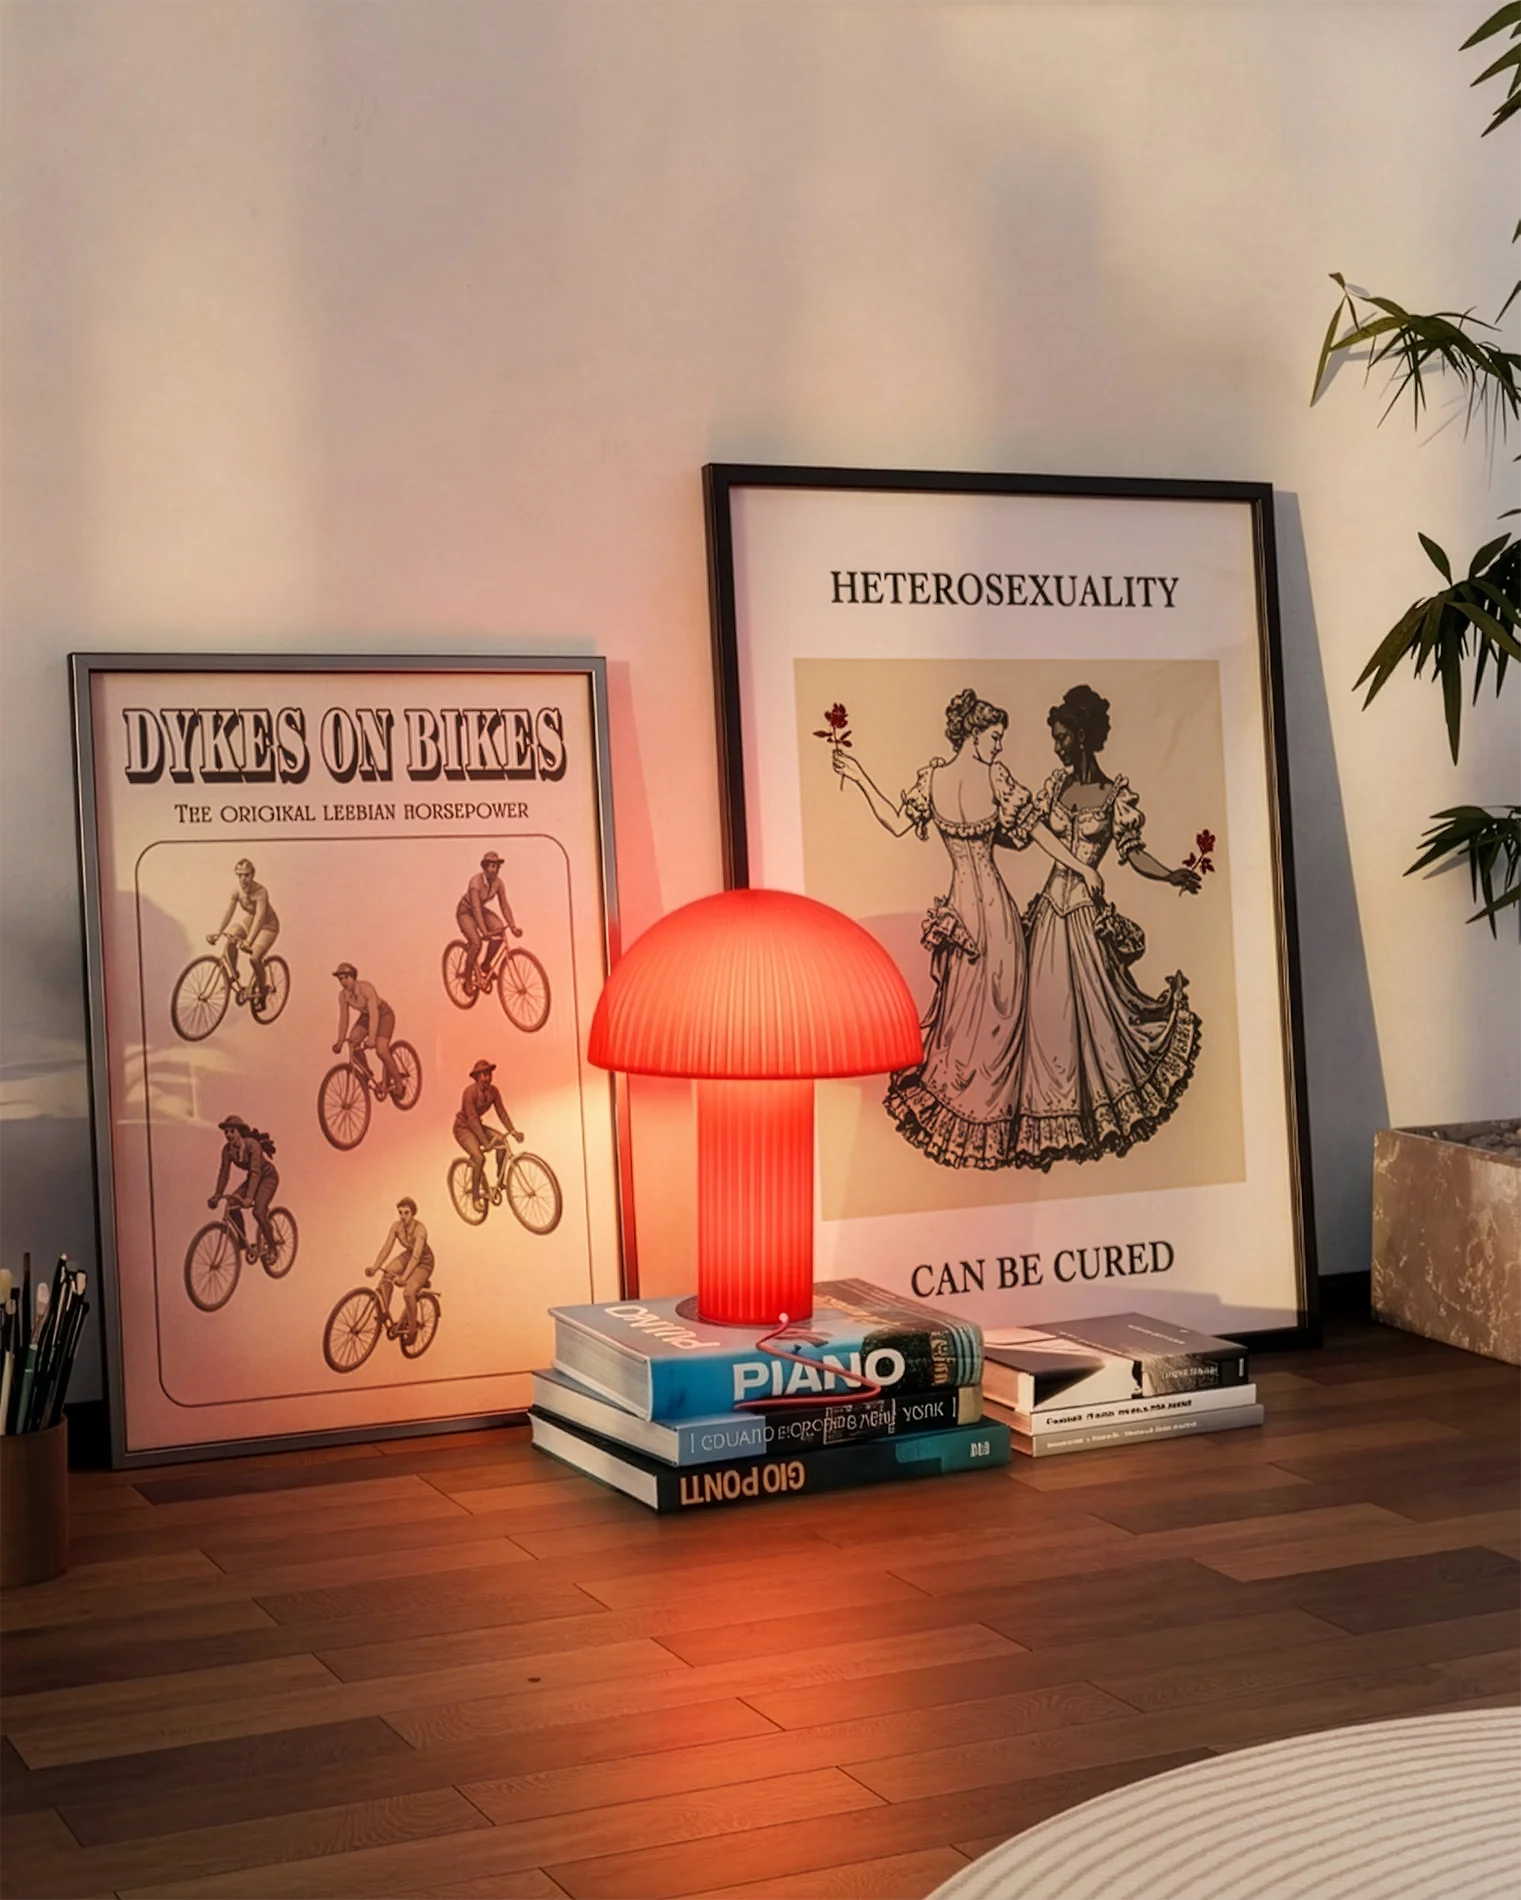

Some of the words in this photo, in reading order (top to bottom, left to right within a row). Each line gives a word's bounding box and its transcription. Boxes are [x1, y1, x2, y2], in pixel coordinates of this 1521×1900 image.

[831, 571, 1180, 607] HETEROSEXUALITY
[123, 707, 310, 784] DYKES
[321, 707, 395, 784] ON
[404, 707, 568, 782] BIKES
[911, 1259, 985, 1298] CAN
[997, 1253, 1044, 1290] BE
[1053, 1240, 1175, 1283] CURED
[732, 1348, 905, 1401] PIANO
[679, 1466, 760, 1506] PONTI
[763, 1461, 806, 1493] GIO
